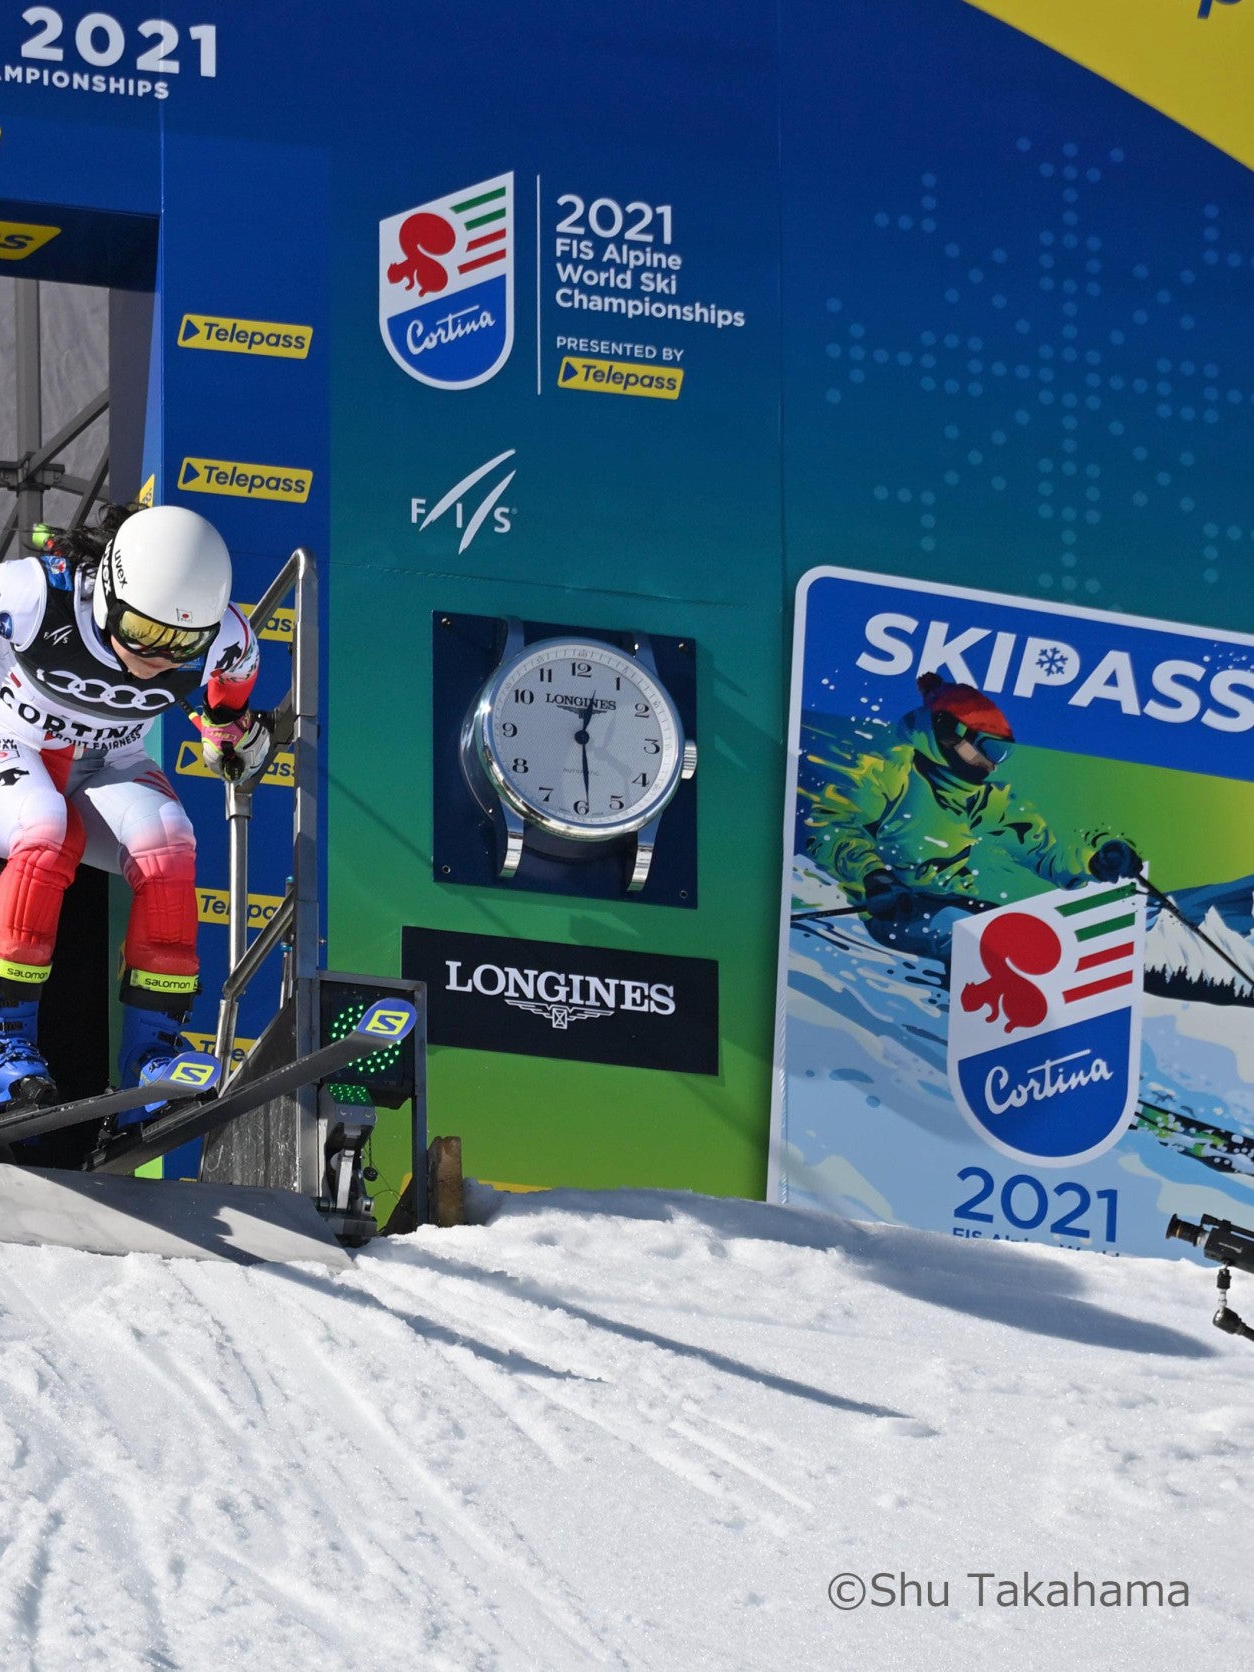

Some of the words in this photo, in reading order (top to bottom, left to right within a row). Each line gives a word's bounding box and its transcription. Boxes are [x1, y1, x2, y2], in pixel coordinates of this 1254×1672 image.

[21, 6, 216, 77] 2021
[555, 194, 672, 245] 2021
[556, 238, 594, 261] FIS
[602, 244, 682, 271] Alpine
[556, 263, 632, 290] World
[640, 273, 676, 295] Ski
[555, 289, 745, 328] Championships
[204, 322, 306, 350] Telepass
[407, 306, 496, 355] Cortina
[557, 336, 657, 359] PRESENTED
[662, 346, 684, 362] BY
[582, 364, 677, 392] Telepass
[204, 465, 306, 494] Telepass
[115, 549, 127, 589] uvex
[539, 668, 552, 682] 11
[571, 662, 592, 678] 12
[855, 612, 1254, 733] SKIPASS
[615, 677, 621, 691] 1
[514, 689, 534, 705] 10
[546, 693, 616, 710] LONGINES
[0, 686, 144, 741] CORTINA
[634, 703, 650, 718] 2
[93, 732, 141, 750] FAIRNESS
[503, 722, 518, 738] 9
[644, 739, 660, 754] 3
[512, 757, 529, 774] 8
[632, 772, 649, 787] 4
[538, 787, 553, 802] 7
[609, 795, 624, 810] 5
[573, 800, 589, 815] 6
[7, 967, 48, 980] salomon
[144, 978, 190, 989] salomon
[446, 960, 676, 1016] LONGINES
[984, 1049, 1113, 1115] Cortina
[953, 1166, 1118, 1243] 2021
